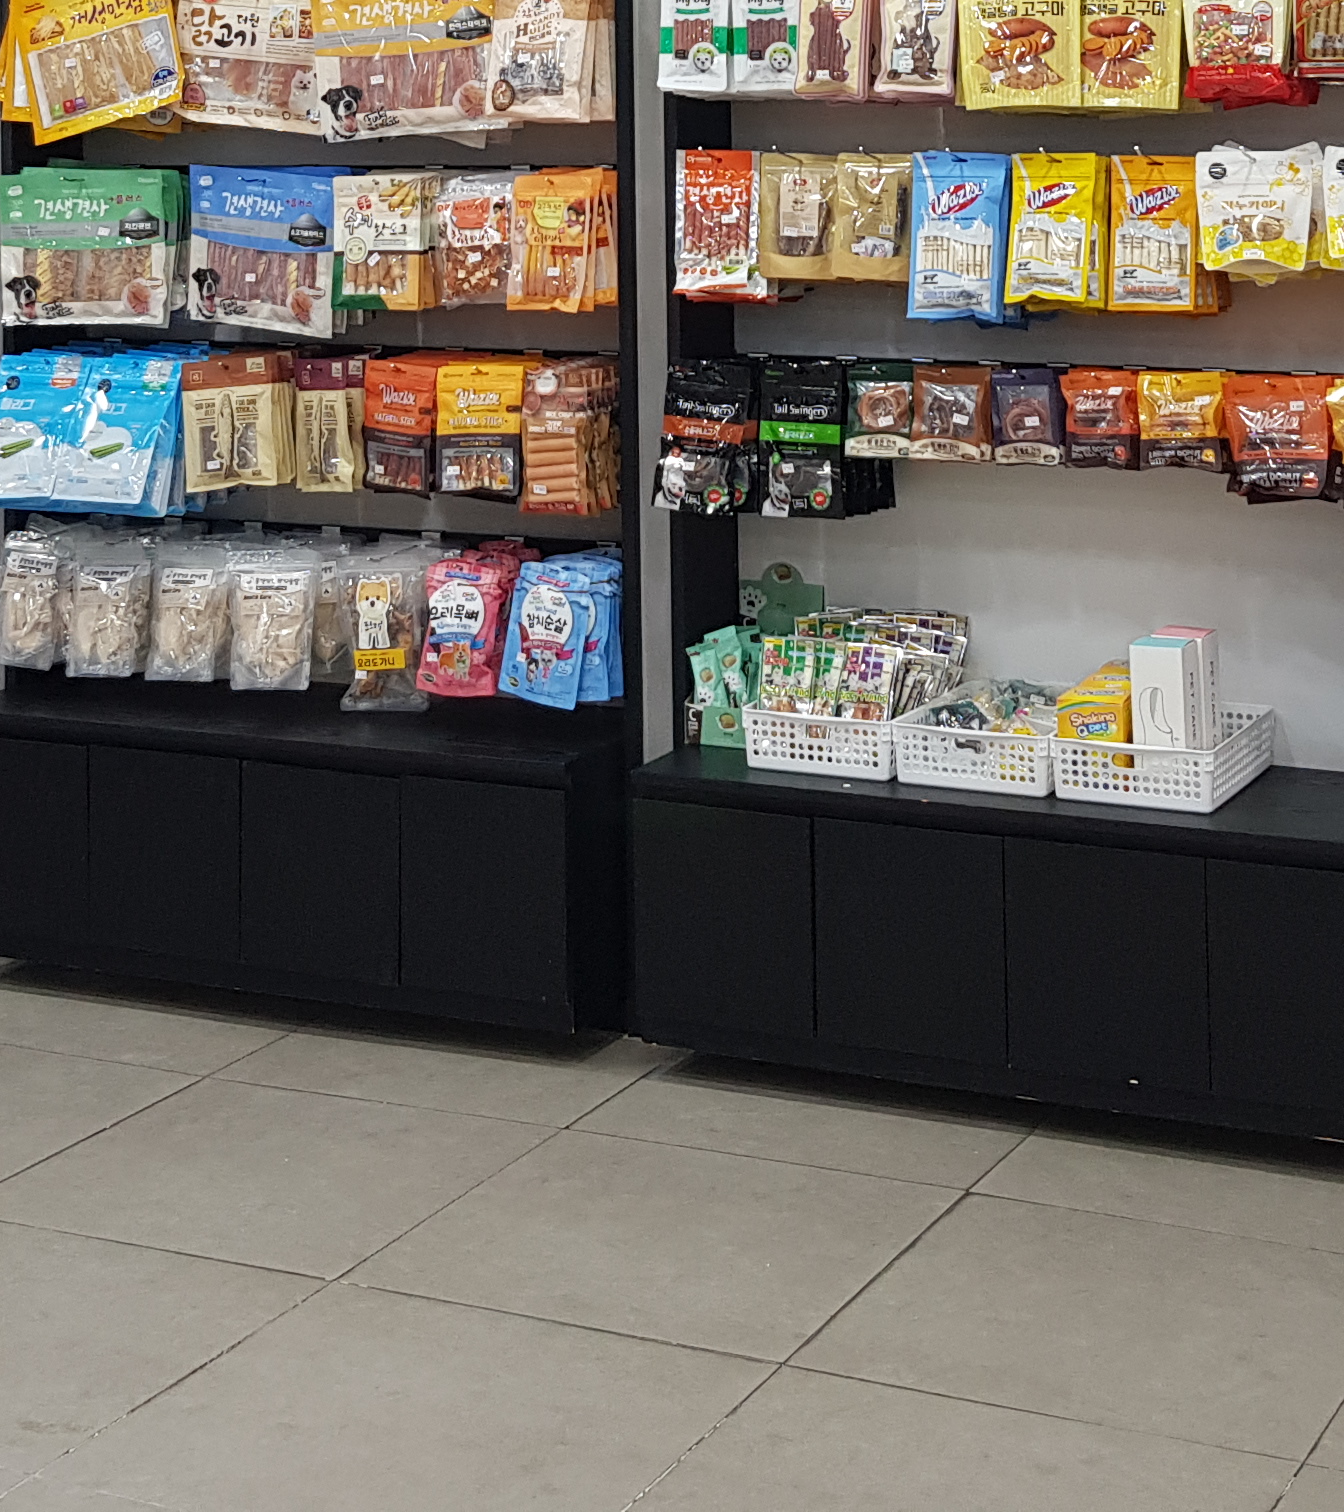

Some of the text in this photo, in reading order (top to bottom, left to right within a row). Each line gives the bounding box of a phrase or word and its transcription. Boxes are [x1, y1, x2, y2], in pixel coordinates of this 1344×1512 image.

[1021, 1, 1066, 18] 고구마
[1121, 0, 1168, 17] 고구마
[34, 196, 110, 221] 견생견사
[222, 191, 285, 218] 견생견사
[428, 605, 480, 623] 오리목뼈
[525, 611, 569, 636] 참치순살
